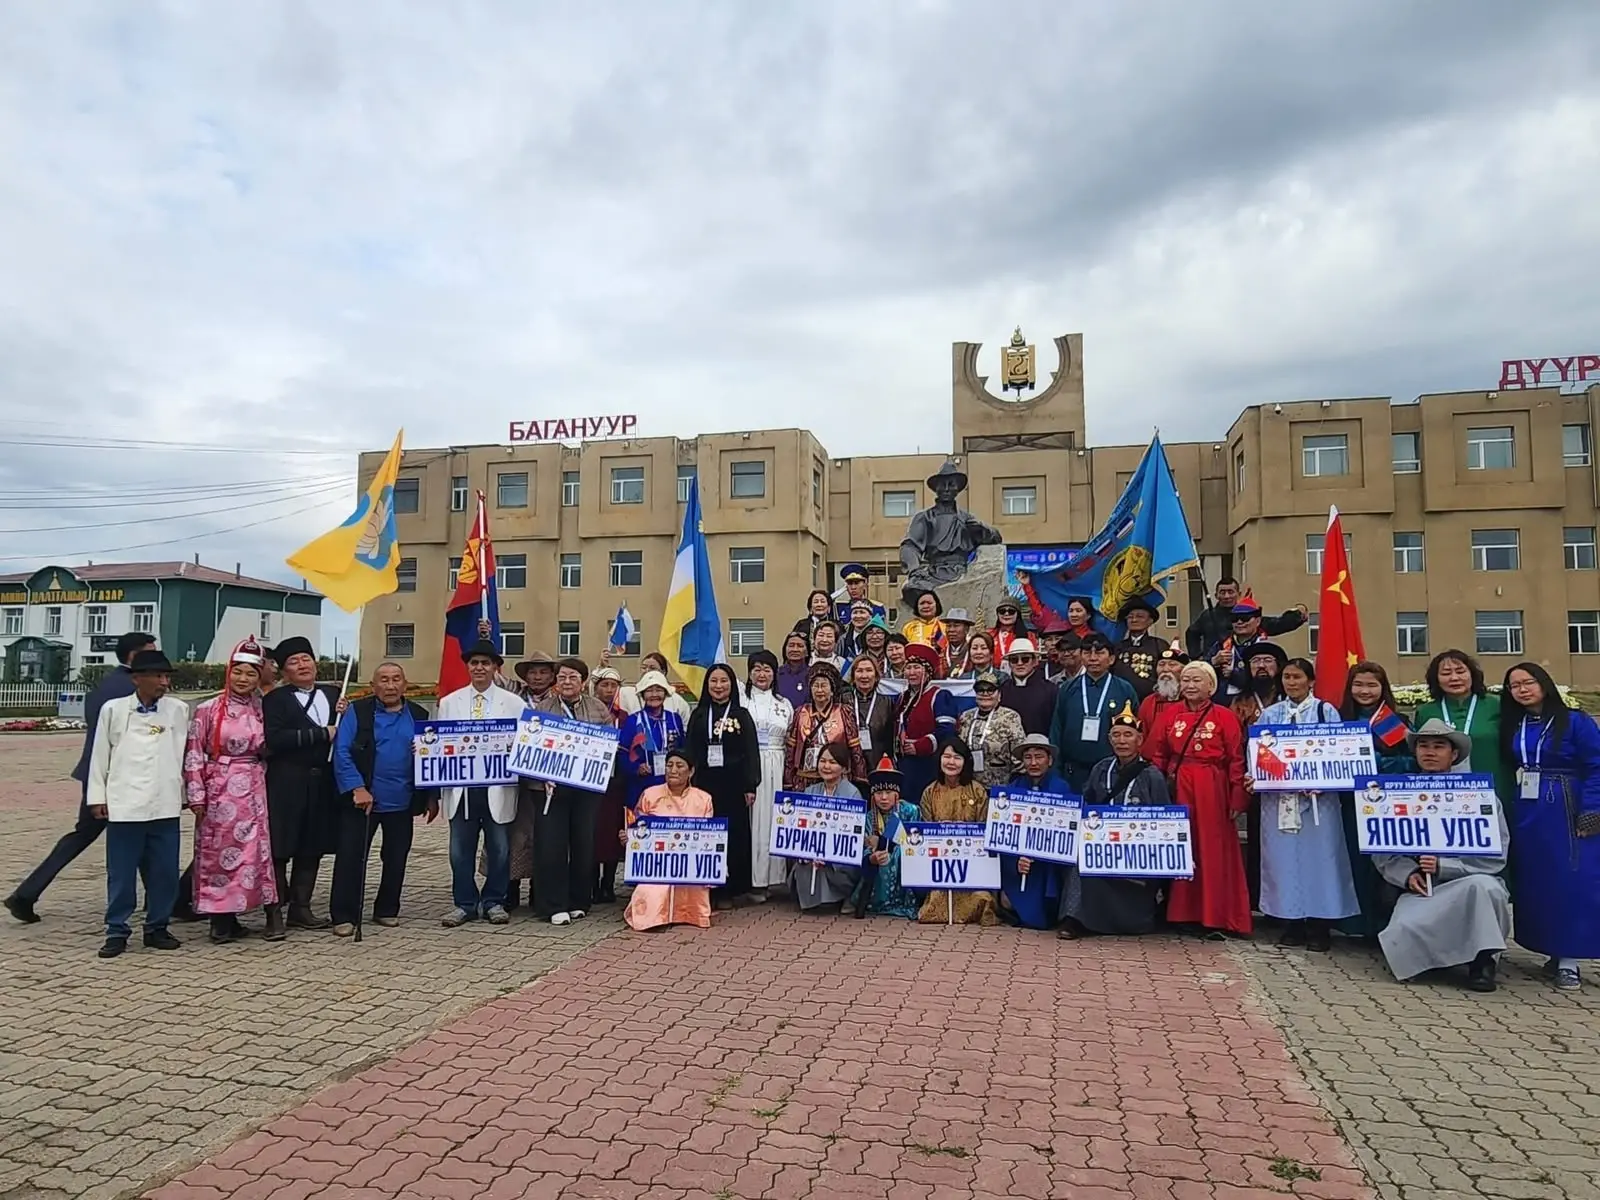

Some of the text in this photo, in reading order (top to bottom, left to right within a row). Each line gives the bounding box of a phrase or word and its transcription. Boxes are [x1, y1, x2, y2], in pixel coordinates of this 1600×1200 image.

[1499, 355, 1600, 391] ДҮҮР
[509, 415, 637, 441] БАГАНУУР
[92, 589, 124, 601] ГАЗАР
[421, 754, 512, 781] ЕГИПЕТ УЛС
[511, 744, 609, 785] ХАЛИМАГ УЛС
[1404, 780, 1446, 789] НАЙРГИЙН
[1453, 780, 1489, 790] НААДАМ
[776, 827, 858, 858] БУРИАД УЛС
[989, 822, 1074, 856] ДЭЭД МОНГОЛ
[1366, 817, 1492, 848] ЯПОН УЛС
[631, 852, 722, 879] МОНГОЛ УЛС
[1085, 843, 1187, 870] ӨВӨРМОНГОЛ
[931, 858, 969, 884] ОХУ
